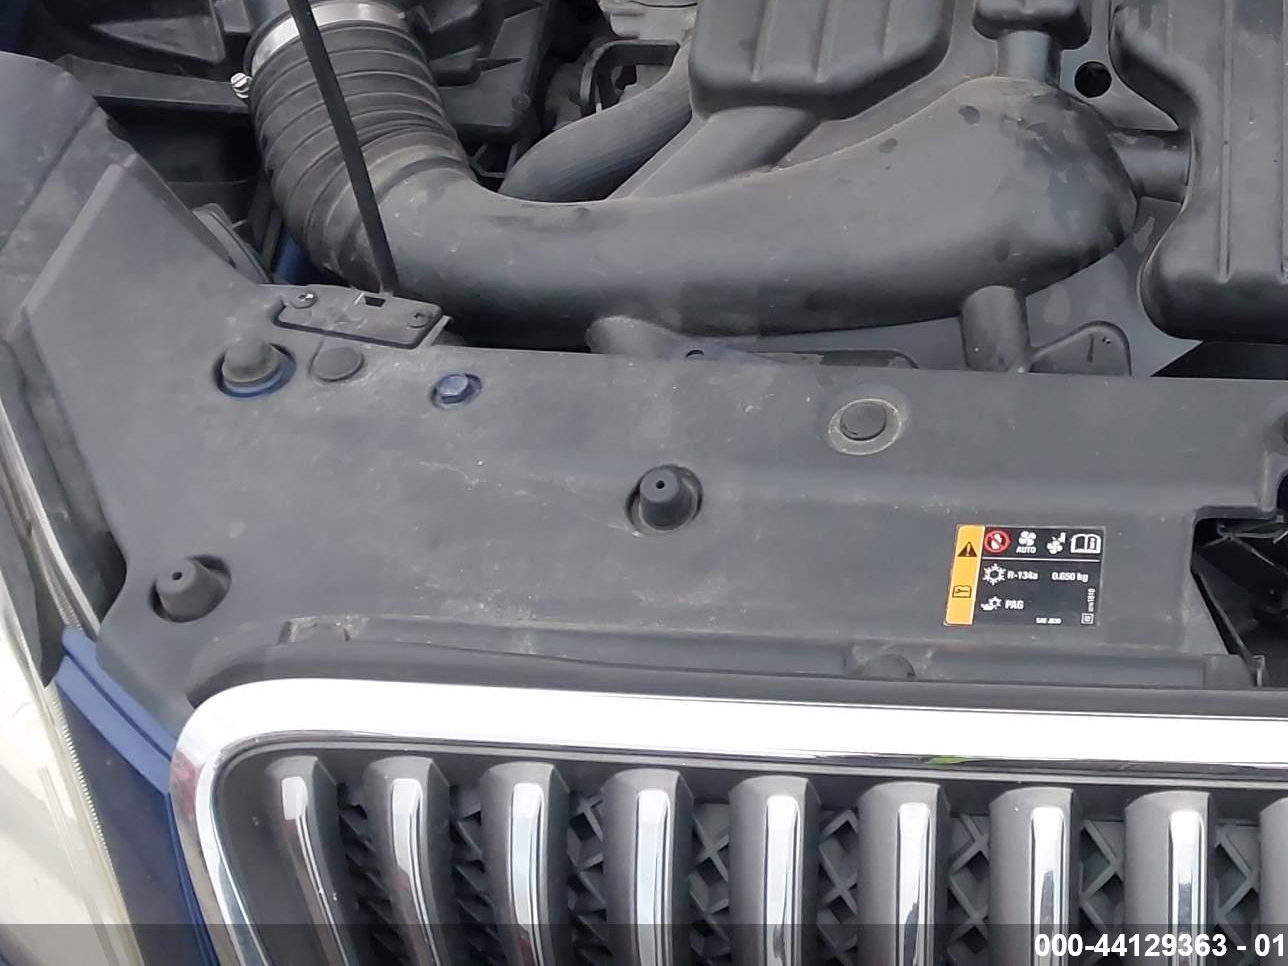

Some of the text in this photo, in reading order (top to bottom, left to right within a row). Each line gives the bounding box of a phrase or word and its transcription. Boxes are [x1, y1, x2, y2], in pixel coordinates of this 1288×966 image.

[1016, 546, 1037, 554] AUTO
[1007, 570, 1089, 583] R-134a 0.650 kg
[1004, 599, 1025, 610] PAG
